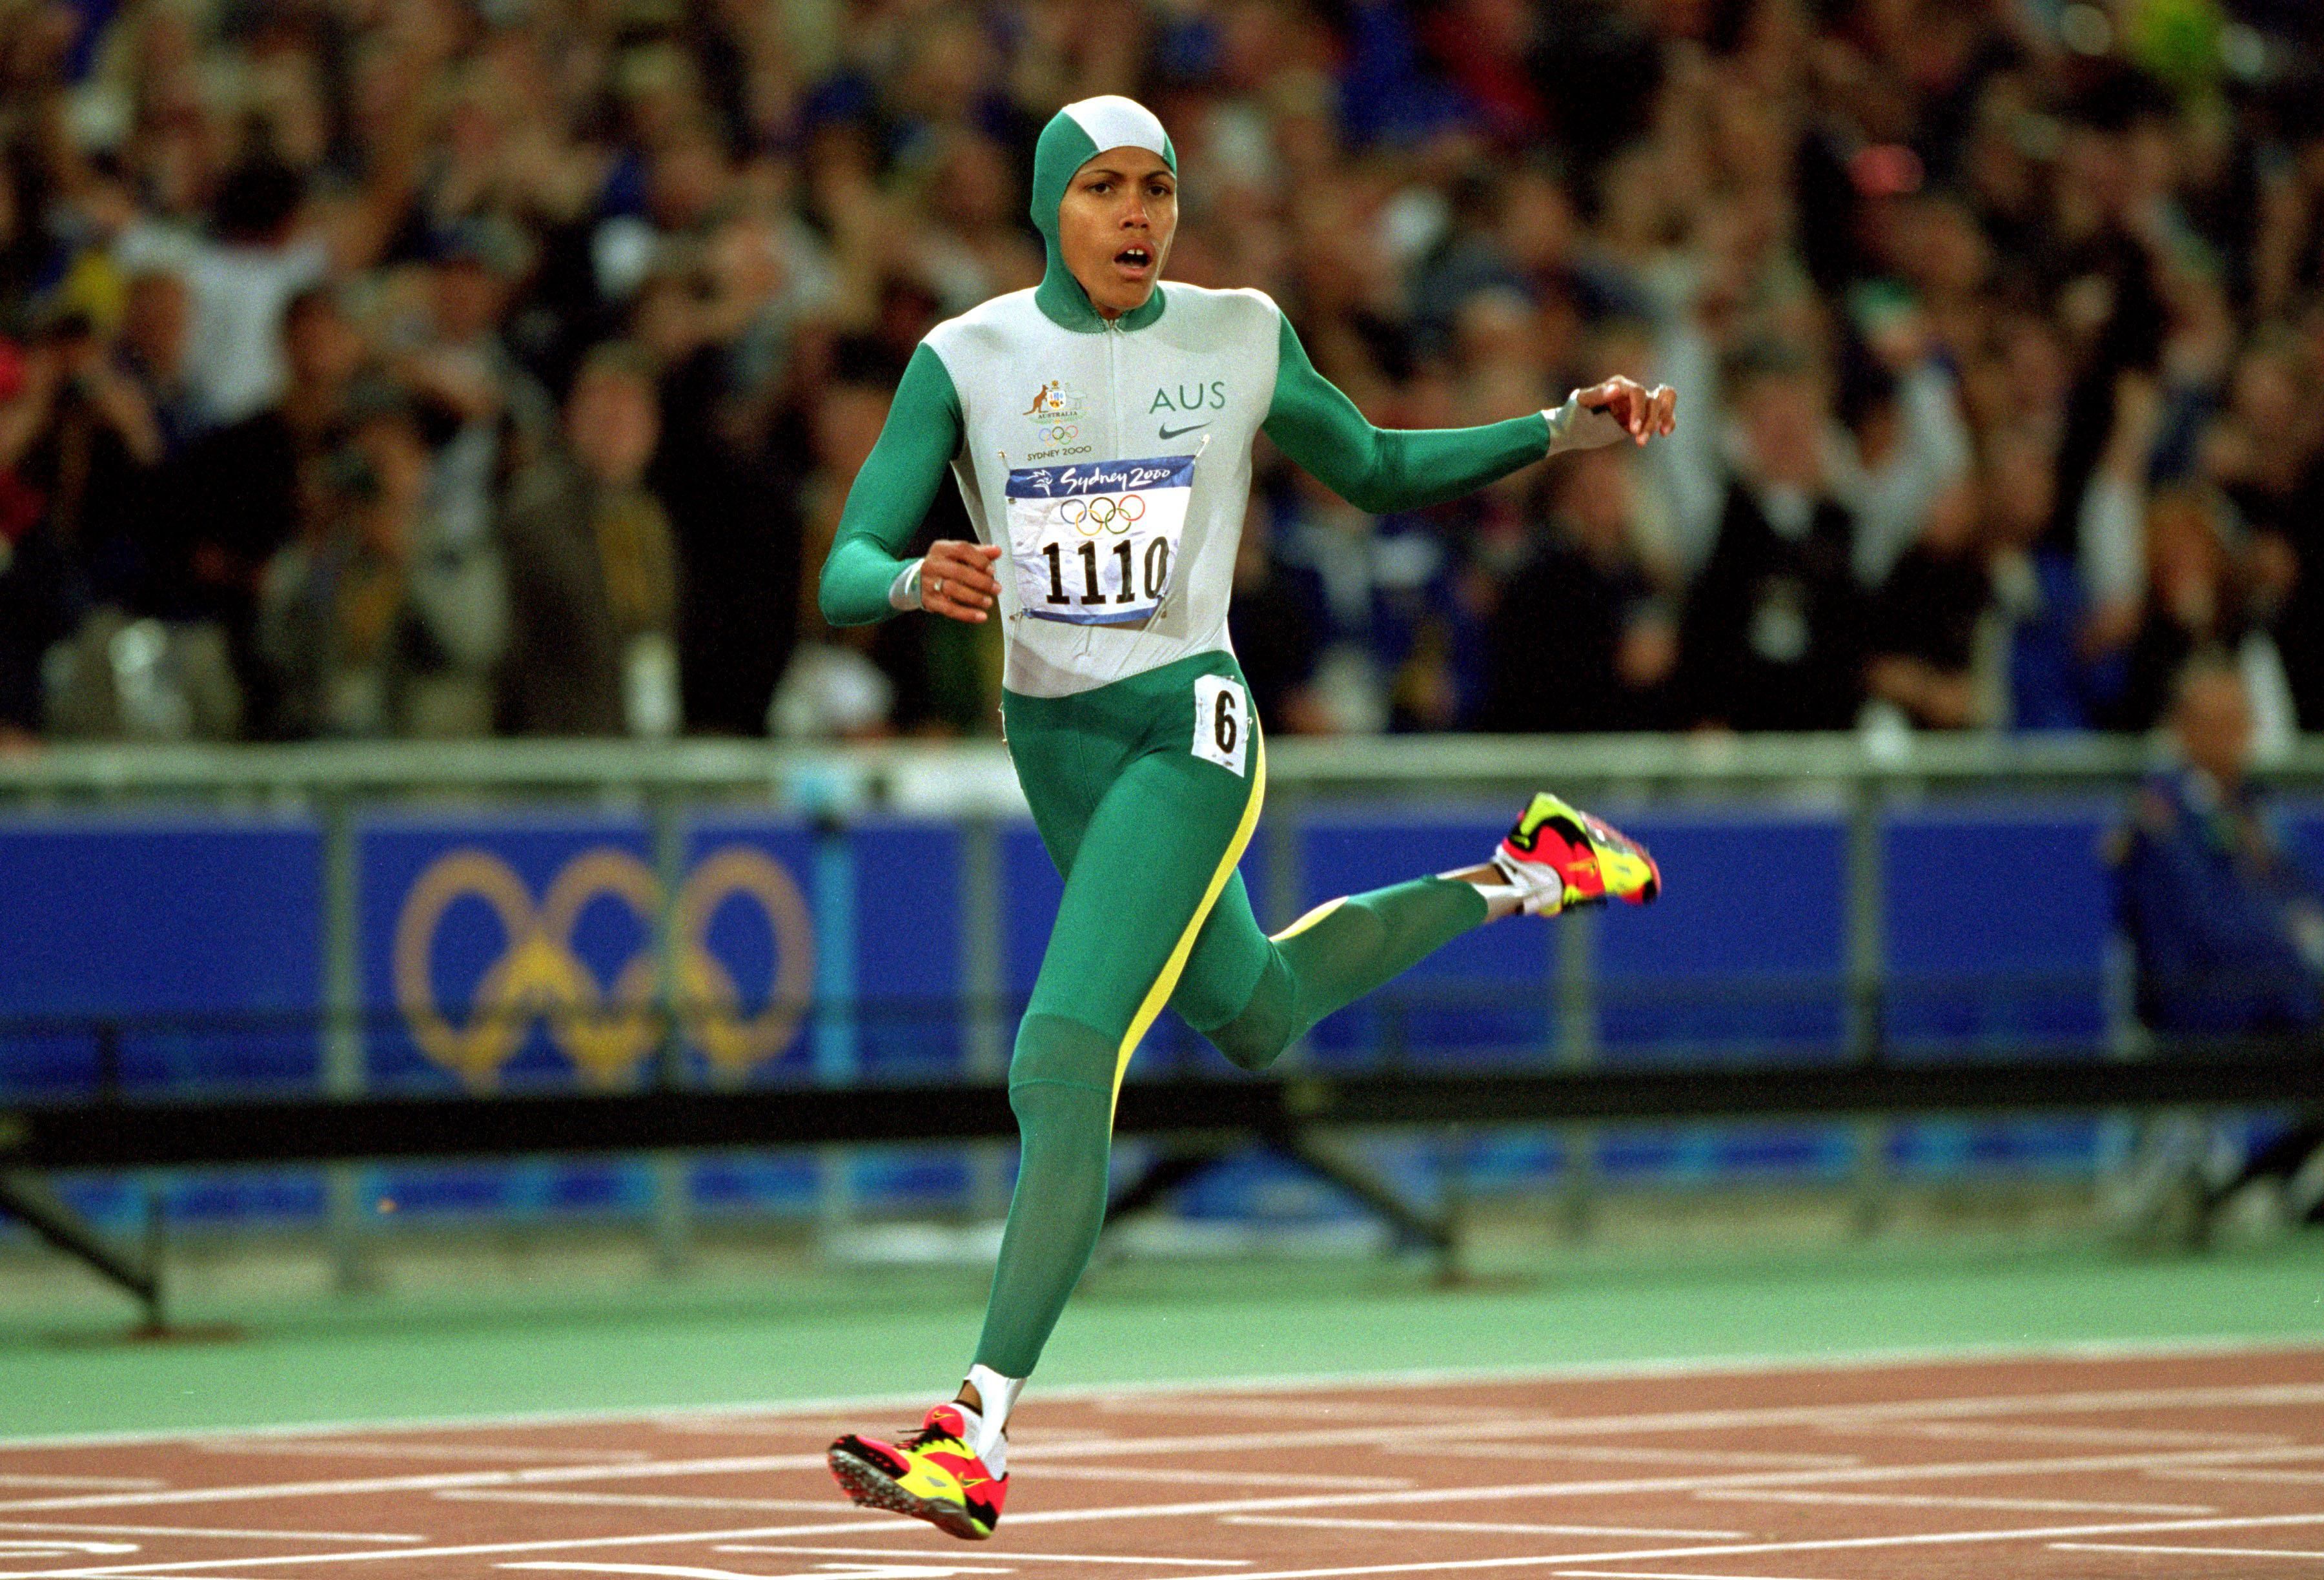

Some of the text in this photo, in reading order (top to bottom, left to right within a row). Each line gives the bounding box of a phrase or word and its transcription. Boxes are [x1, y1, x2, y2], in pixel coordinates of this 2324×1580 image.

[1149, 381, 1226, 414] AUS
[1028, 446, 1091, 461] SYDNEY 2000
[1060, 467, 1170, 495] Sydney 2000
[1043, 536, 1170, 605] 1110
[1215, 690, 1236, 754] 6
